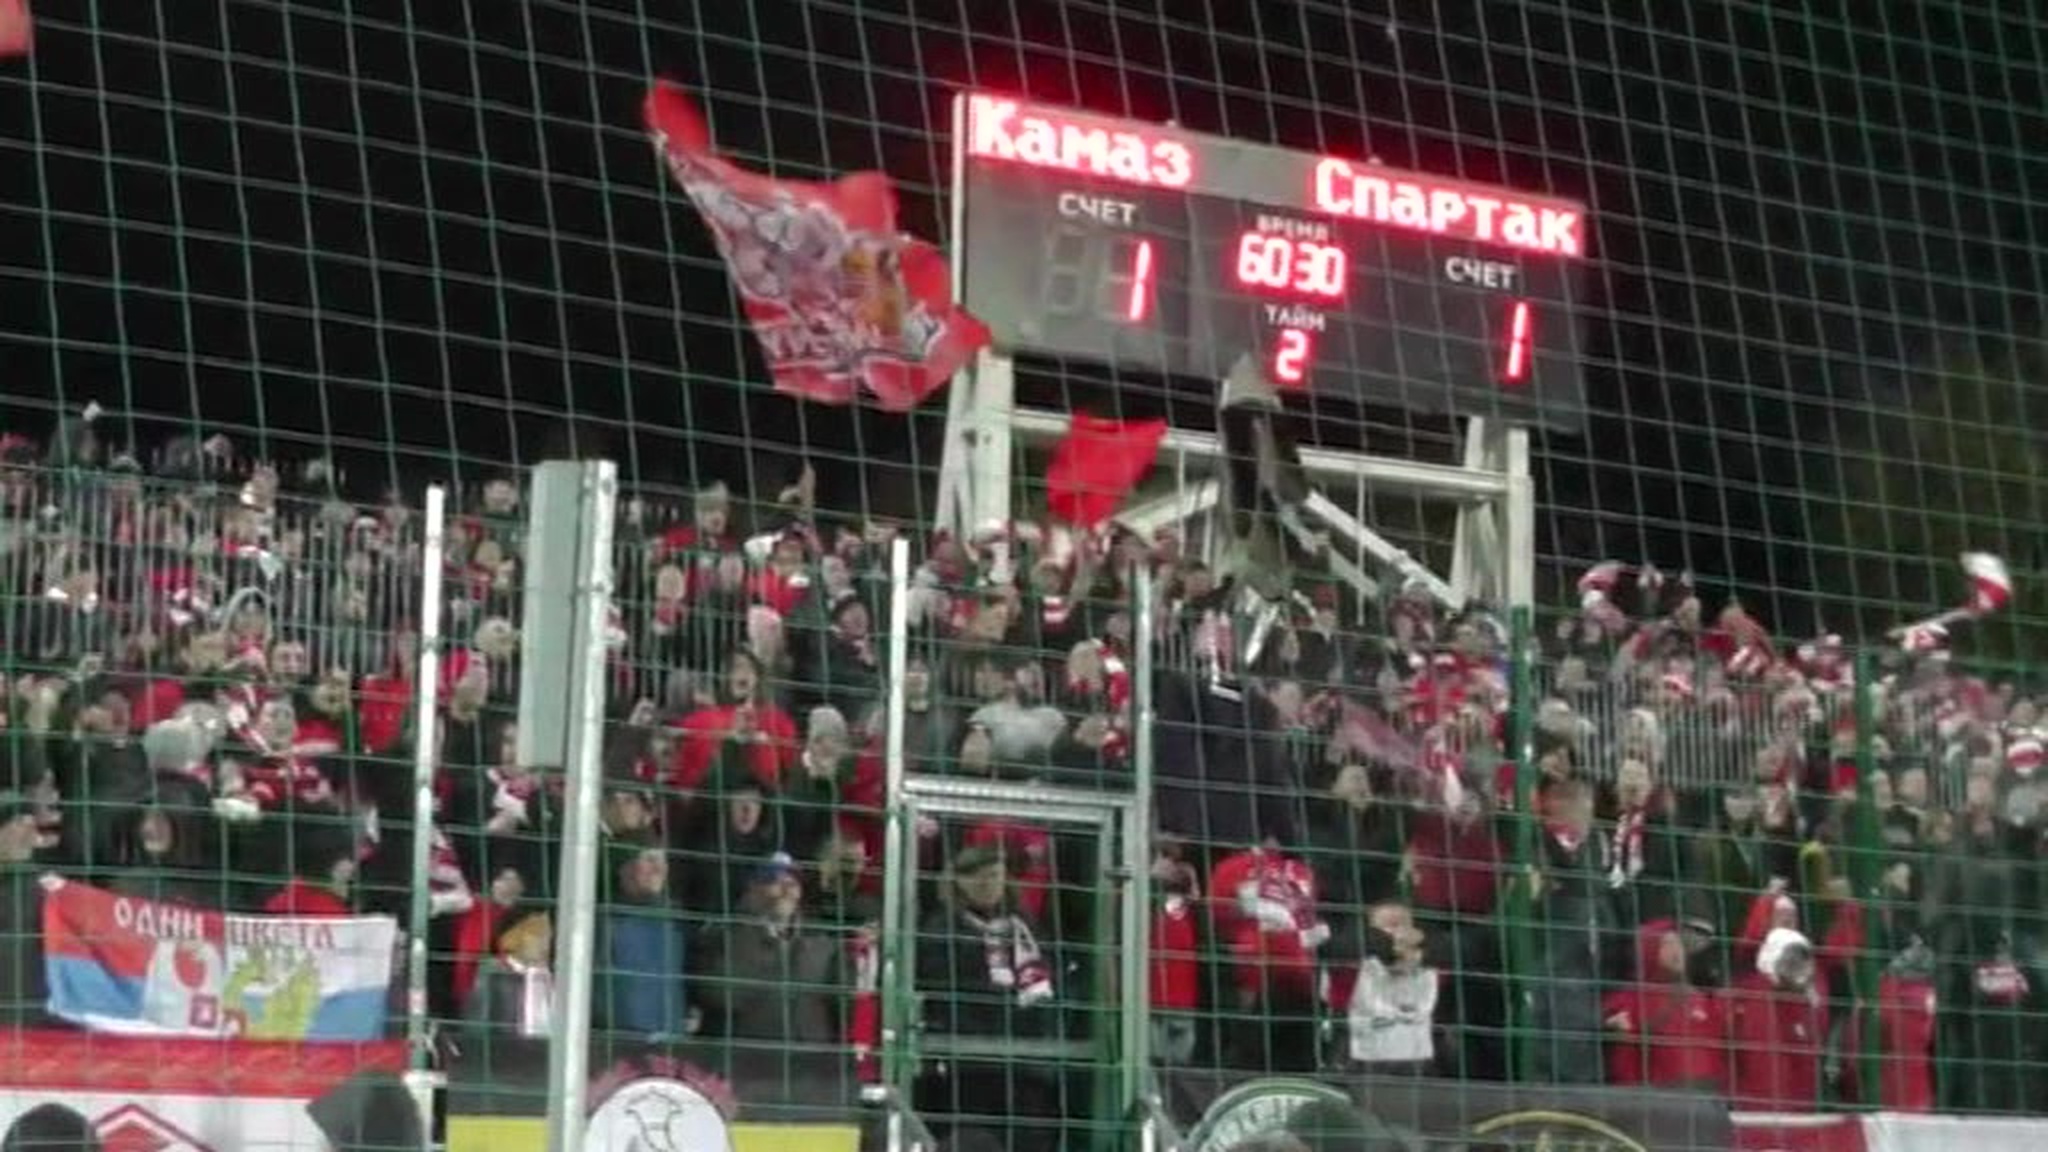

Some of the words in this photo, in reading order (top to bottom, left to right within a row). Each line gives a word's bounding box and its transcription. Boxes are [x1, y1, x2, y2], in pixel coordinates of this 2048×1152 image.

[970, 96, 1191, 187] Камаз
[1058, 192, 1136, 226] СЧЕТ
[1315, 157, 1578, 255] Спартак
[1129, 240, 1152, 321] 1
[1444, 256, 1517, 289] СЧЕТ
[1275, 328, 1307, 381] 2
[1507, 301, 1527, 378] 1
